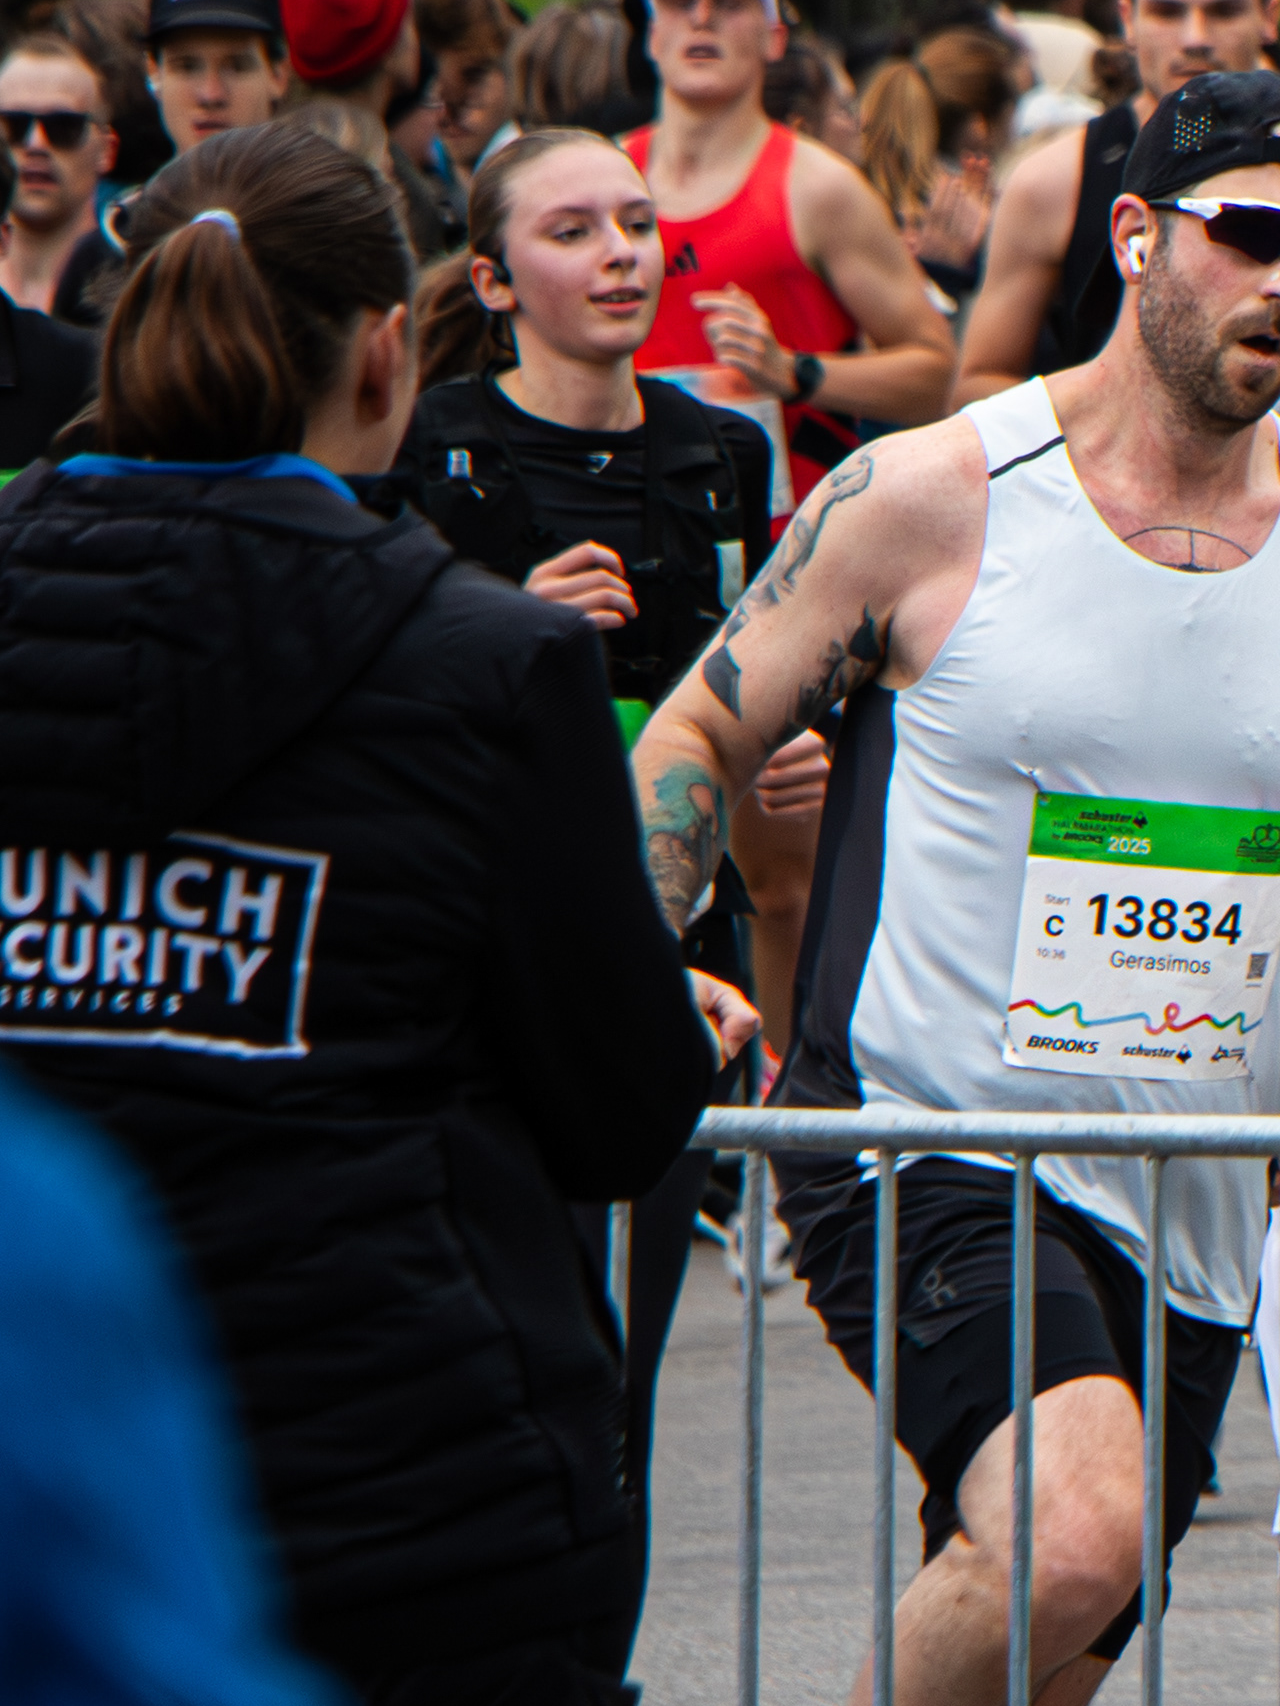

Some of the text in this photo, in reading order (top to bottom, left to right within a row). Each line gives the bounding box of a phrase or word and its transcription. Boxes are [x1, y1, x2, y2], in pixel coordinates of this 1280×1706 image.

[1107, 835, 1152, 856] 2025
[1043, 894, 1070, 907] Start
[1044, 914, 1065, 938] C
[1087, 893, 1243, 945] 13834
[1109, 949, 1212, 976] Gerasimos
[1027, 1035, 1100, 1055] BROOKS
[1121, 1044, 1176, 1059] schuster
